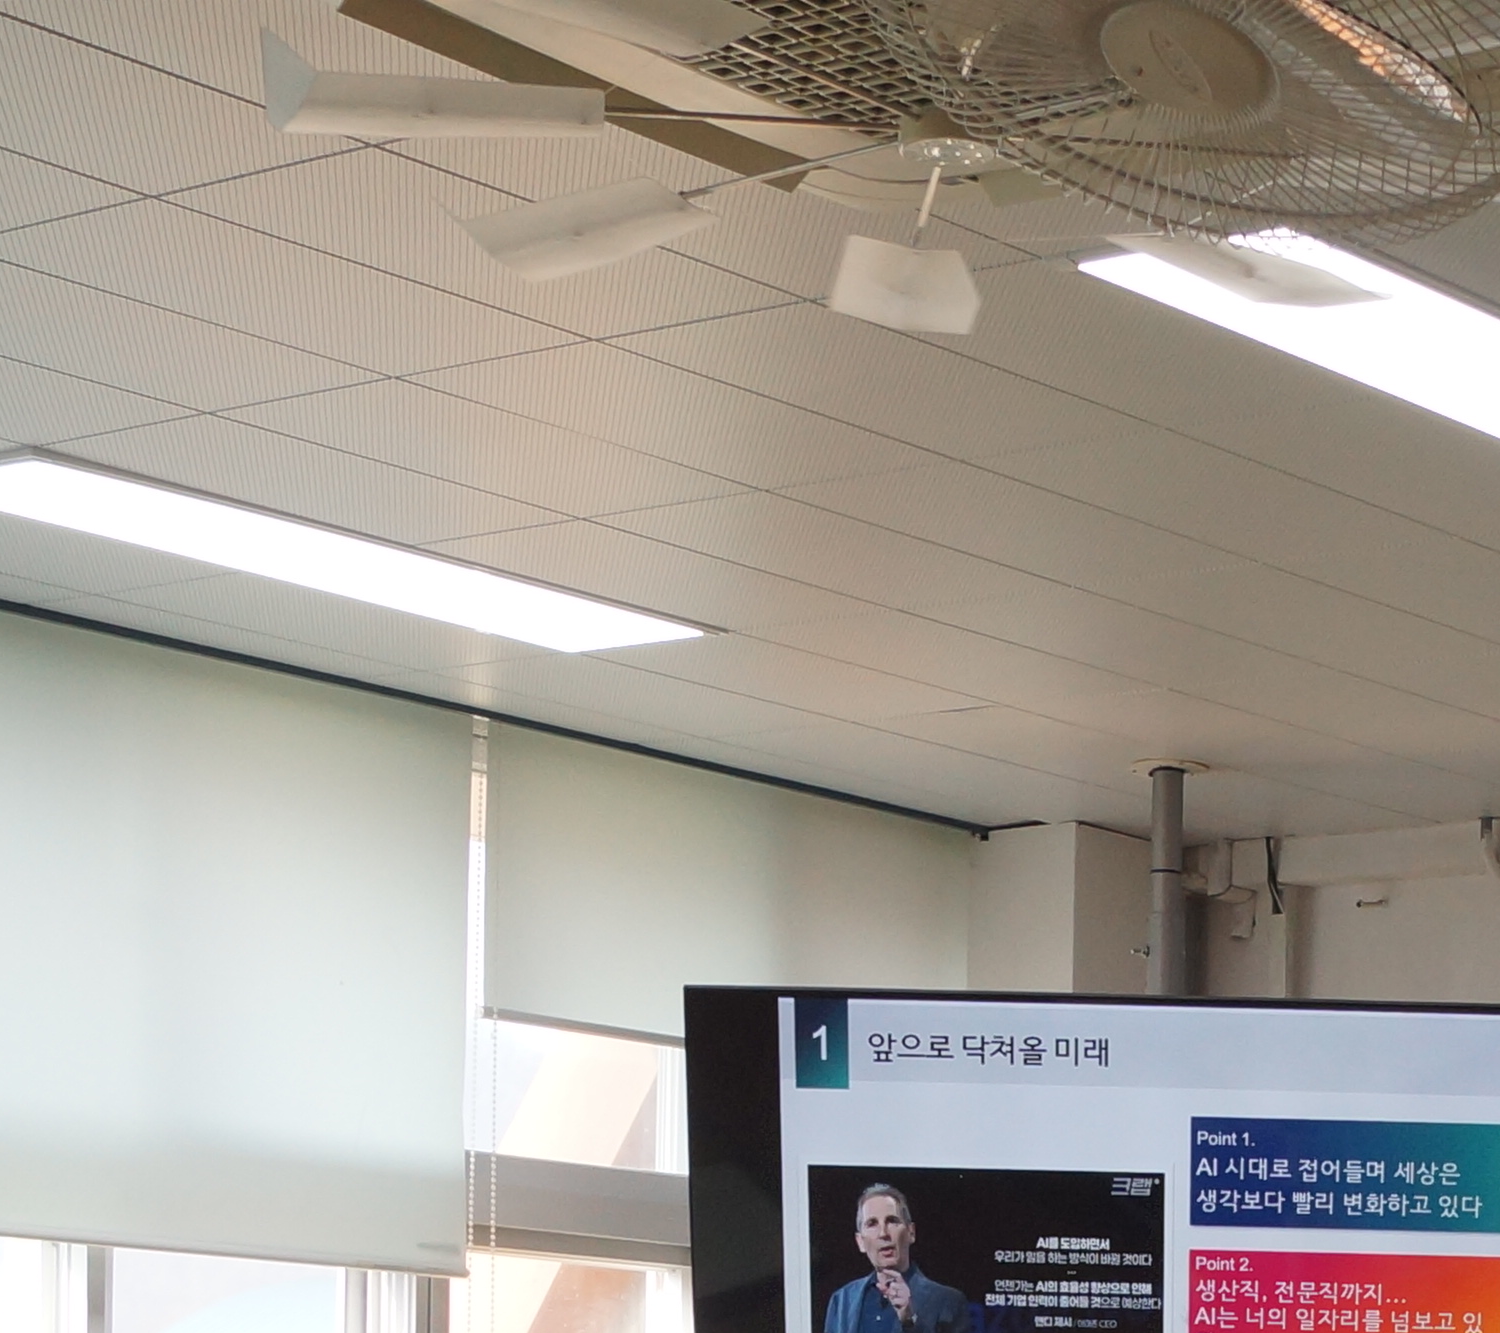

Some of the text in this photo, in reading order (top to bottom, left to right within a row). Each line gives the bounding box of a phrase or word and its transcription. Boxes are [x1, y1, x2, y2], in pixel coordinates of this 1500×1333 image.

[812, 1024, 828, 1061] 1
[868, 1033, 1110, 1067] 앞으로 닥쳐올 미래
[1196, 1130, 1256, 1147] Point 1.
[1196, 1157, 1461, 1186] AI 시대로 접어들며 세상은
[1111, 1177, 1153, 1196] 크랩
[1196, 1189, 1483, 1219] 생각보다 빨리 변화하고 있다
[994, 1250, 1025, 1264] 우리가
[1122, 1253, 1153, 1266] 것이다
[1195, 1256, 1254, 1273] Point 2.
[1035, 1281, 1058, 1293] AI의
[1195, 1279, 1407, 1306] 생산직, 전문직까지...
[1194, 1307, 1239, 1329] AI는
[1245, 1307, 1287, 1330] 너의
[1296, 1308, 1384, 1333] 일자리를
[1391, 1311, 1456, 1333] 넘보고
